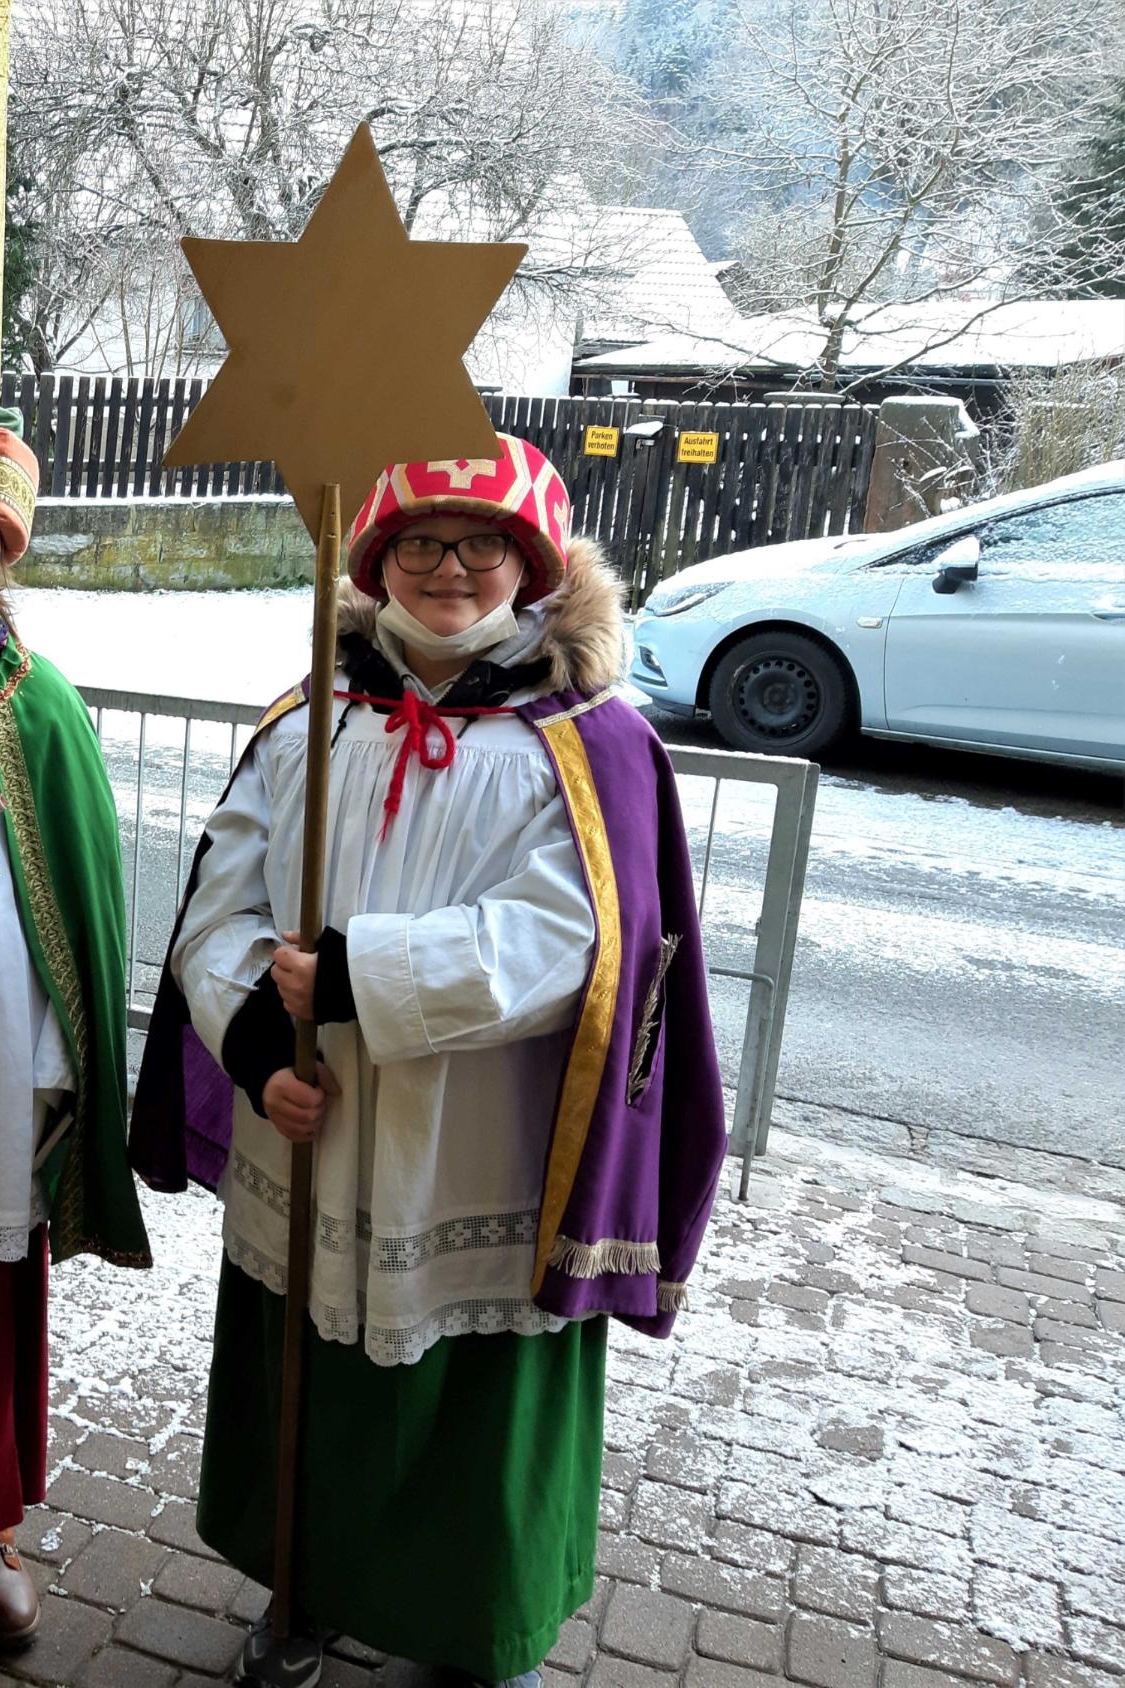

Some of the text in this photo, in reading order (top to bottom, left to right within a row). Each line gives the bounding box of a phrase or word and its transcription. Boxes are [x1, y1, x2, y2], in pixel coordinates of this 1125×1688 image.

[591, 431, 613, 440] Parken
[684, 437, 713, 445] Ausfahrt
[588, 442, 615, 450] verboten
[681, 448, 714, 458] freihalten
